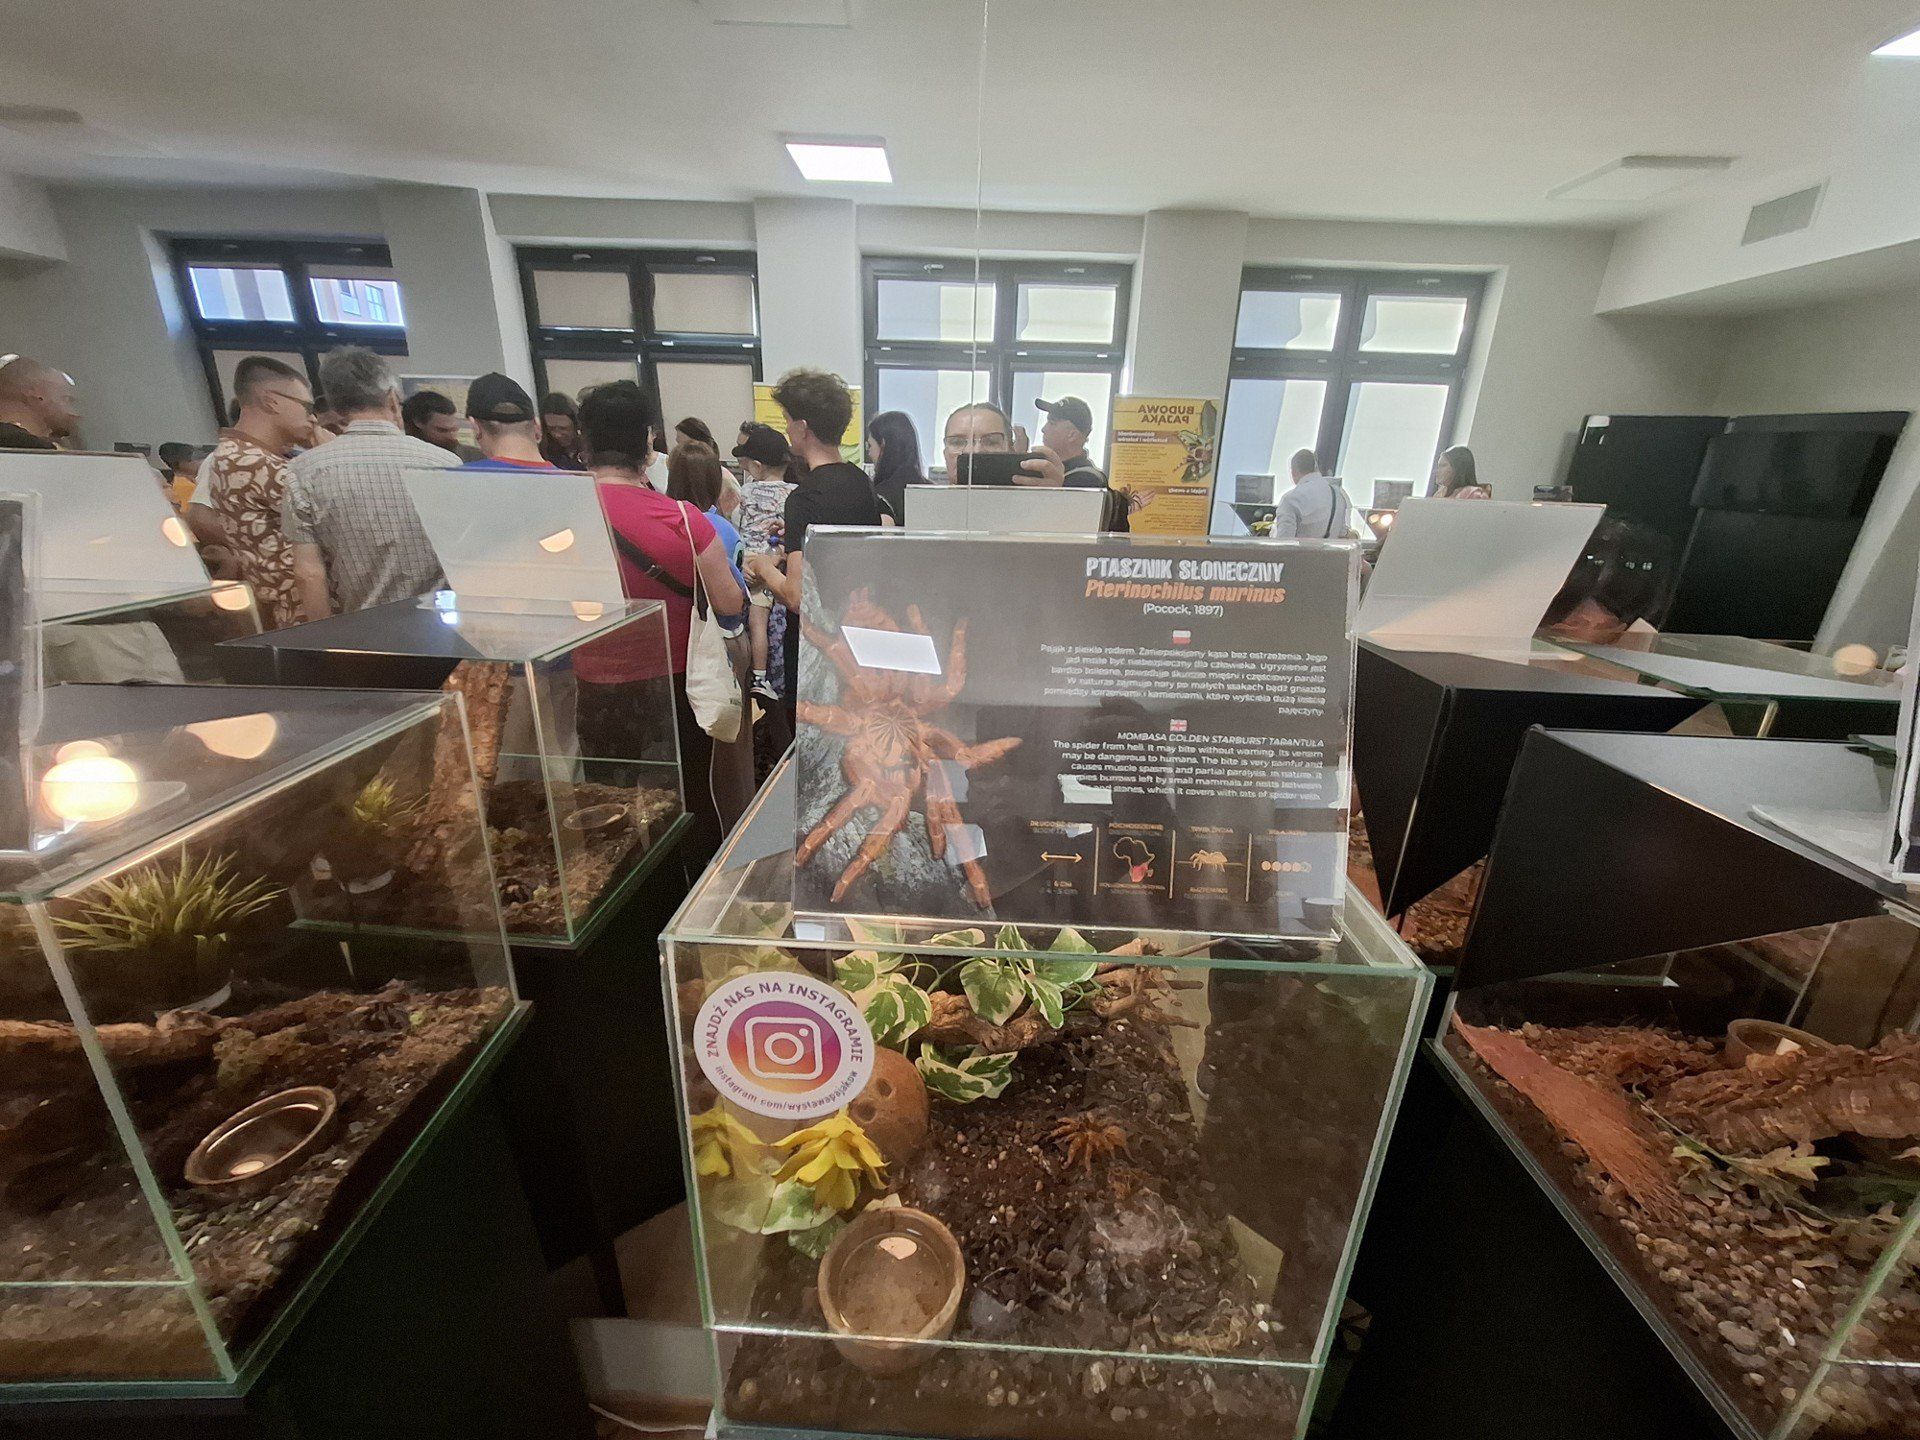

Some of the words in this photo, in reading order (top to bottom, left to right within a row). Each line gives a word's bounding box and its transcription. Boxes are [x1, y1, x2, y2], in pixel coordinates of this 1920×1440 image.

[1086, 557, 1173, 579] PTASZNIK
[1179, 560, 1284, 583] SŁONECZNY
[1085, 579, 1204, 601] Pterinochilus
[1210, 585, 1286, 603] murinus
[1143, 603, 1191, 615] (Pocock,
[1194, 604, 1224, 617] 1897)
[1231, 651, 1248, 659] bez
[1305, 653, 1328, 662] Jego
[1117, 732, 1166, 741] MOMBASA
[1169, 734, 1210, 743] GOLDEN
[1211, 735, 1267, 745] STARBURST
[1268, 737, 1324, 747] TARANTULA
[1053, 740, 1070, 748] The
[1072, 742, 1100, 750] spider
[1102, 742, 1125, 750] from
[1127, 742, 1144, 750] hell.
[1178, 745, 1195, 753] bite
[1198, 747, 1234, 755] without
[1237, 748, 1275, 757] warning.
[1062, 752, 1082, 761] may
[1084, 752, 1096, 760] be
[1098, 753, 1146, 762] dangerous
[1201, 756, 1219, 764] The
[1221, 757, 1239, 765] bite
[1241, 758, 1248, 766] is
[1250, 760, 1269, 768] very
[1305, 760, 1323, 768] and
[1104, 764, 1137, 772] muscle
[1139, 766, 1173, 774] spasms
[1175, 766, 1193, 774] and
[1139, 774, 1154, 782] left
[1156, 775, 1166, 784] by
[1168, 776, 1193, 784] small
[706, 1004, 727, 1058] ZNAJDŹ
[725, 986, 755, 1007] NAS
[759, 983, 782, 993] NA
[788, 983, 863, 1063] INSTAGRAMIE
